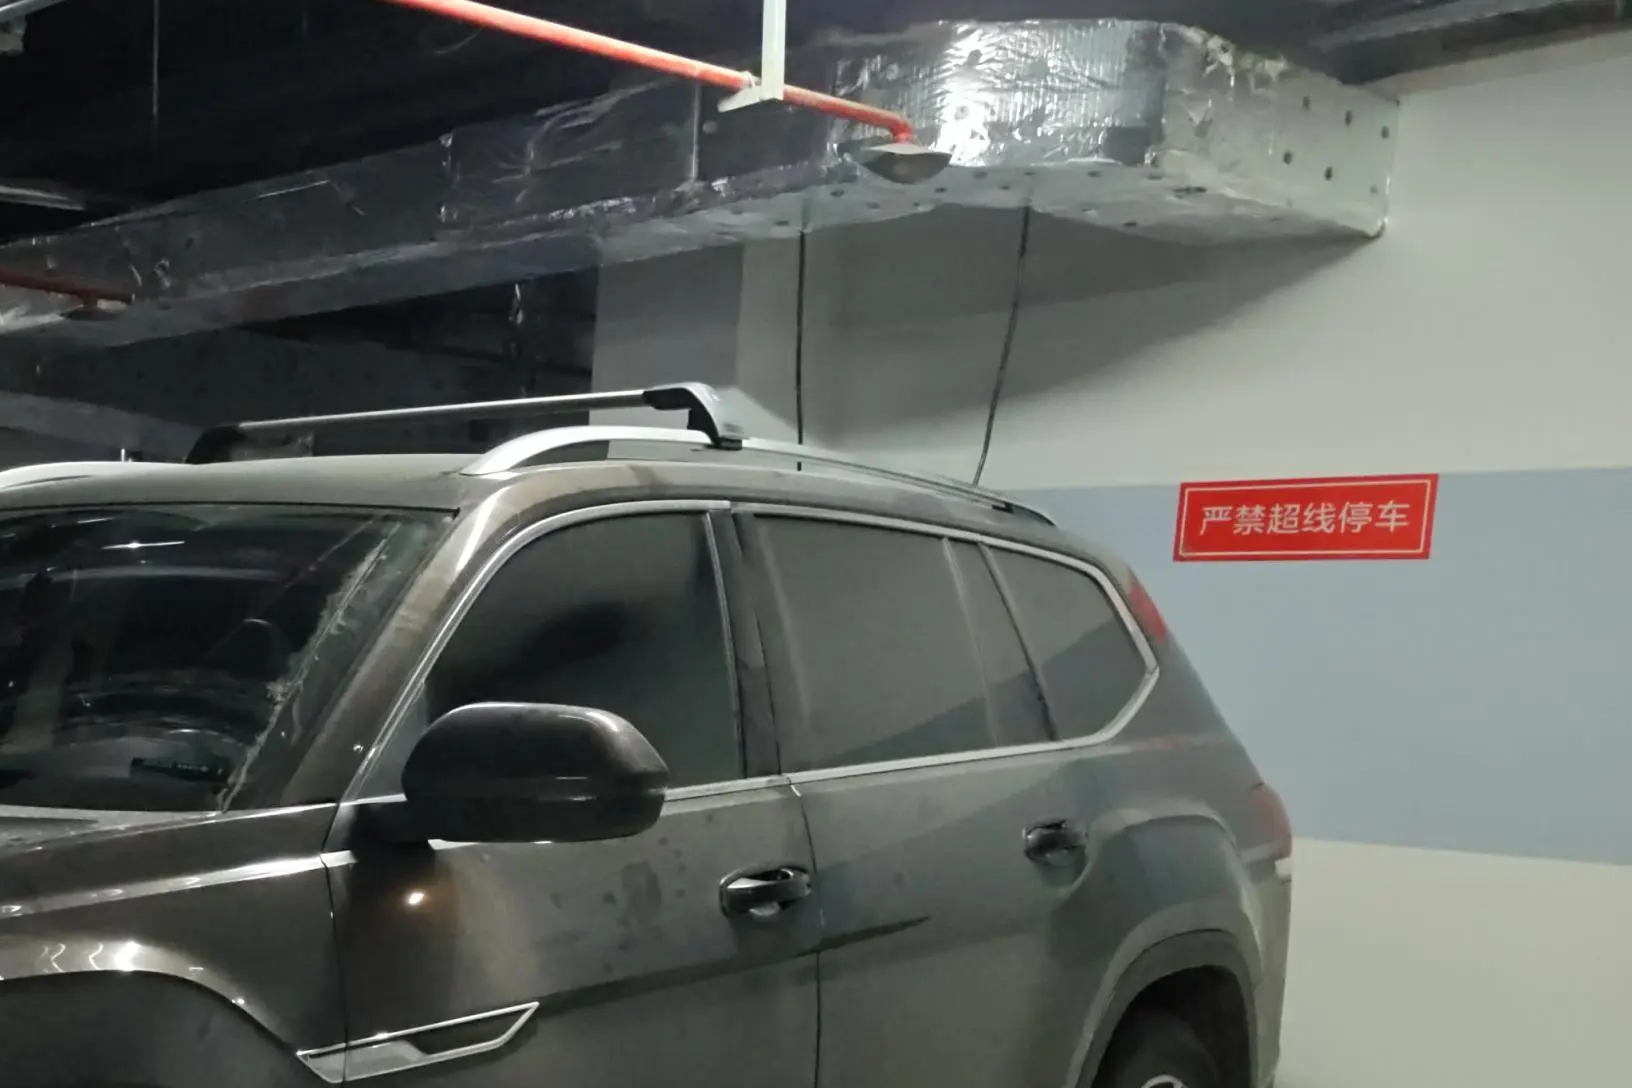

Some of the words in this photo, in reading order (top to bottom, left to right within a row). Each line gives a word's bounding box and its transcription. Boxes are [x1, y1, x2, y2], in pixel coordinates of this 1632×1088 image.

[1199, 499, 1411, 536] 严禁超线停车
